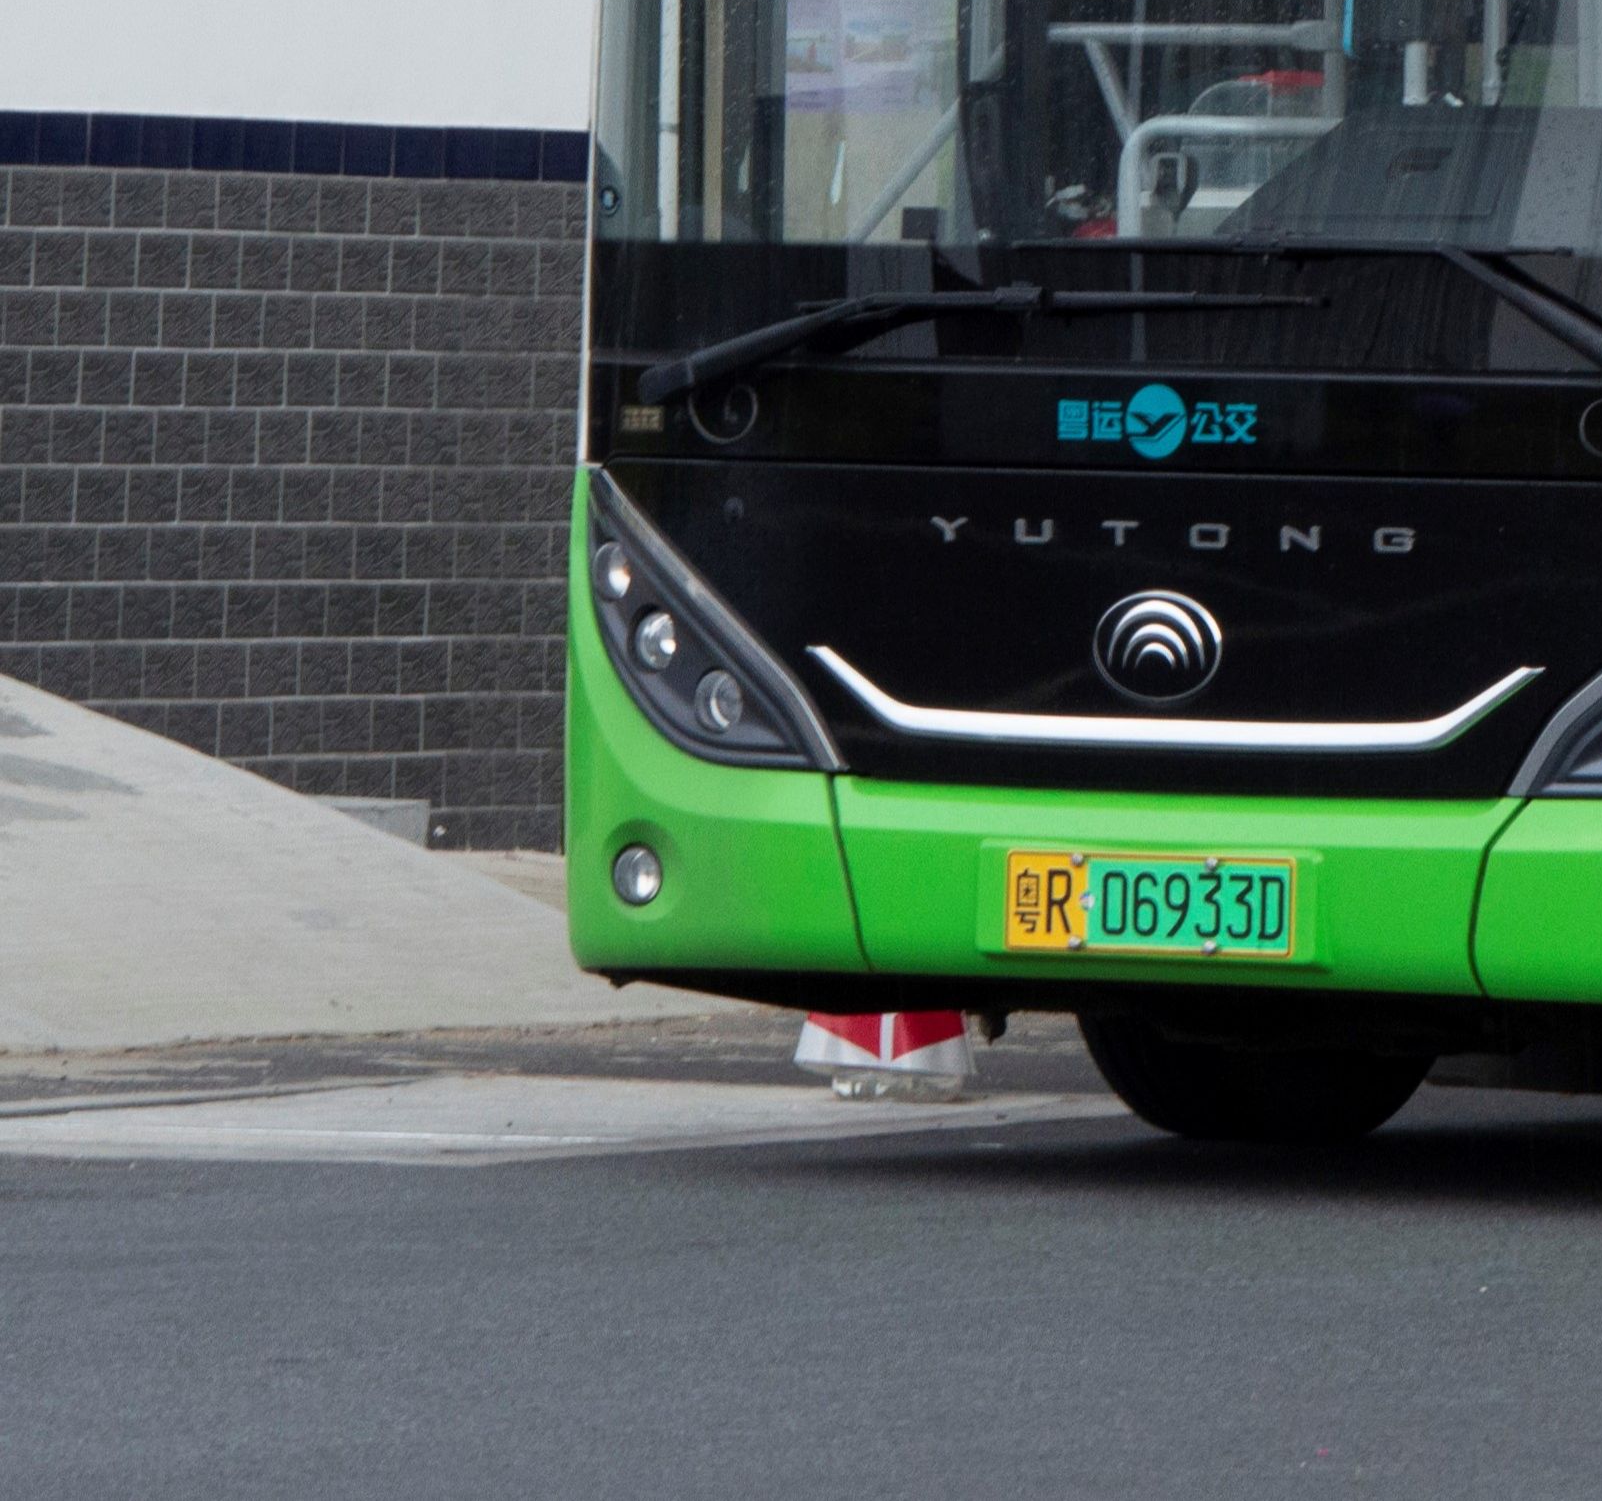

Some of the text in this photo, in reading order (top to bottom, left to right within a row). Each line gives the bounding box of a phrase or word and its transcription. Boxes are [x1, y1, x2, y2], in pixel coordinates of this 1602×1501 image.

[1190, 401, 1259, 444] 公交
[929, 515, 1417, 554] YUTONG
[1013, 867, 1073, 935] 粤R
